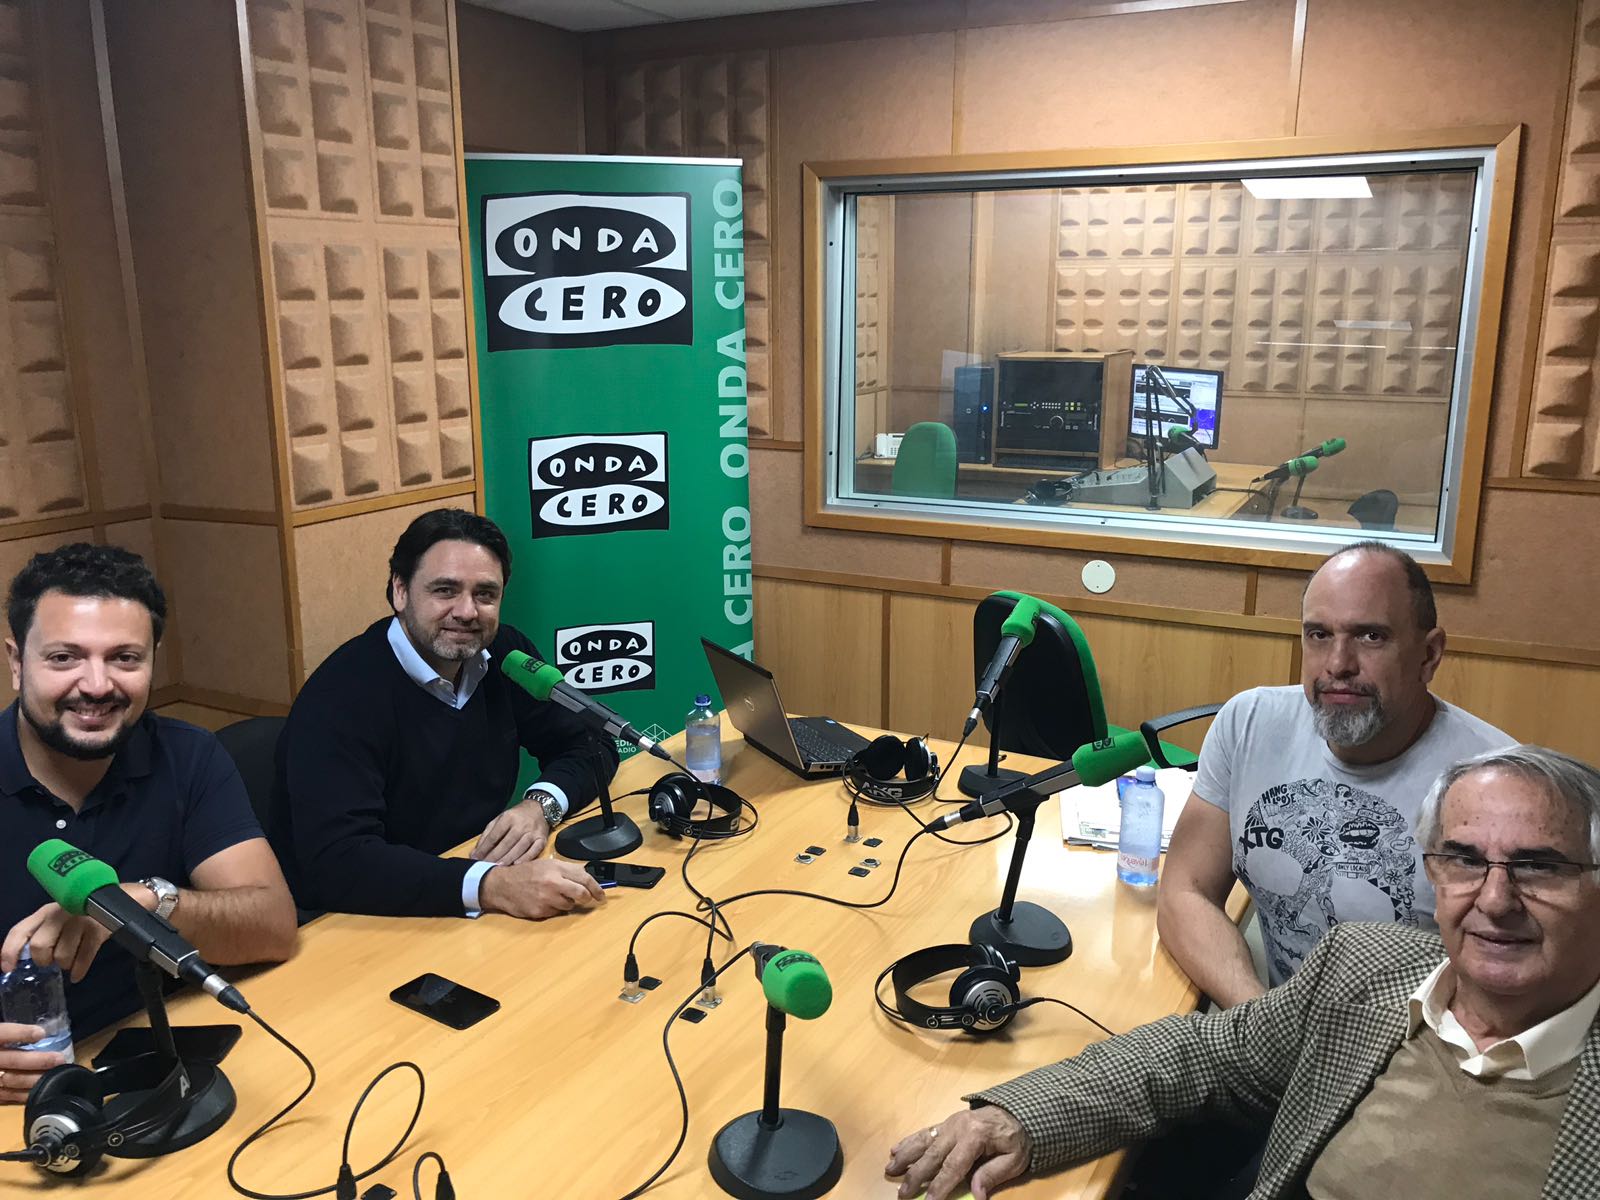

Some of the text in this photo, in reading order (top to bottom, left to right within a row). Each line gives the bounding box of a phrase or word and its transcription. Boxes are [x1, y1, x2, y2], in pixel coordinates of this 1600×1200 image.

[513, 226, 659, 258] ONDA
[712, 178, 745, 310] CERO
[524, 285, 662, 322] CERO
[716, 328, 749, 479] ONDA
[549, 455, 647, 478] ONDA
[556, 493, 648, 518] CERO
[721, 506, 753, 625] CERO
[569, 637, 640, 655] ONDA
[574, 664, 640, 684] CERO
[1261, 784, 1288, 804] HANG
[1273, 793, 1296, 808] LOOSE
[1239, 826, 1284, 855] XTG
